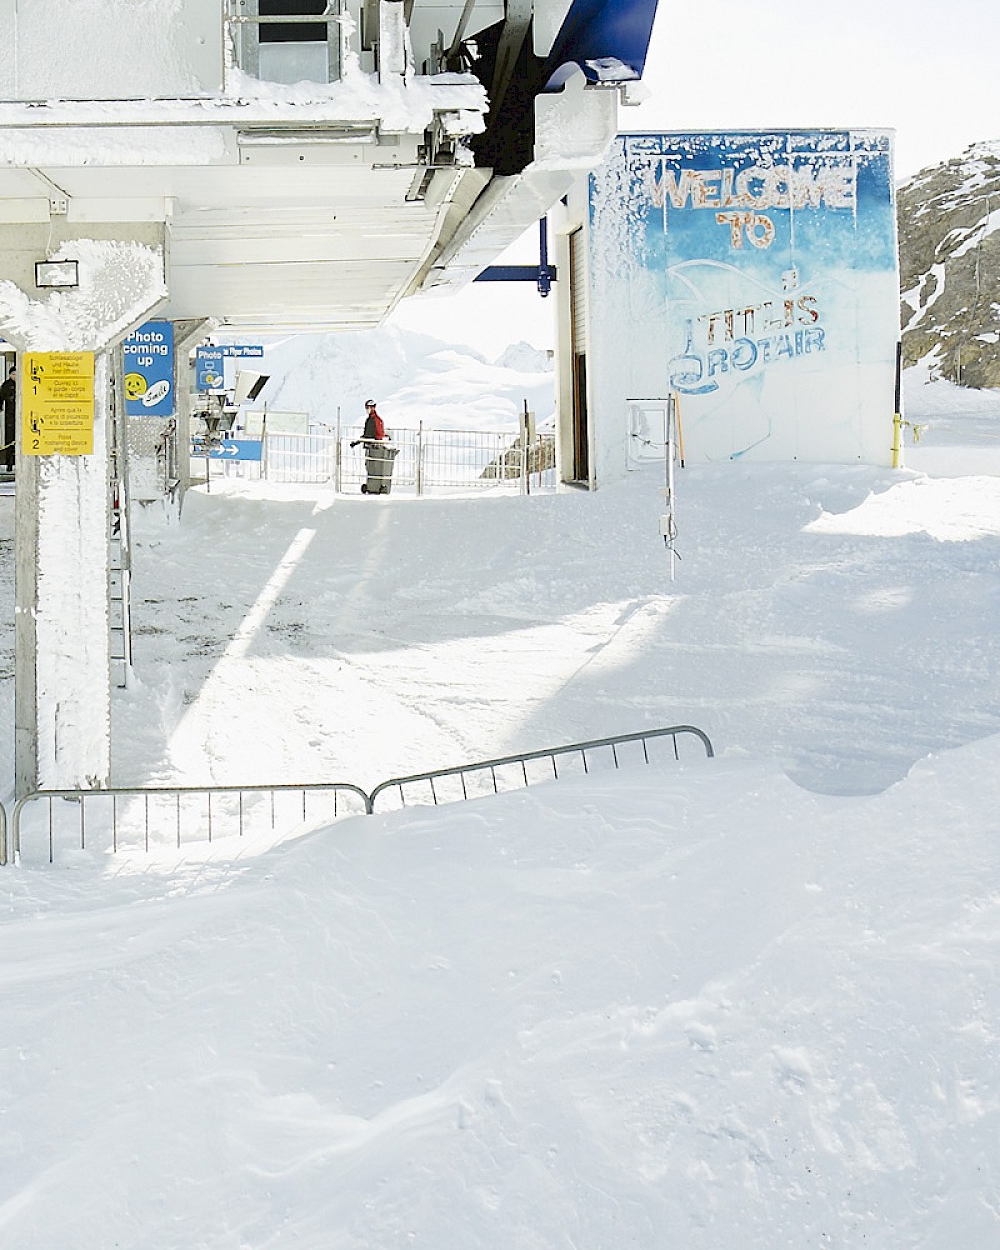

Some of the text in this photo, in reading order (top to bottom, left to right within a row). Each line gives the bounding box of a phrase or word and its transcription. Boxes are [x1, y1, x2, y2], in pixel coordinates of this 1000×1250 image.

[643, 165, 857, 210] WELCOME
[715, 210, 776, 250] TO
[697, 295, 820, 346] TITLIS
[127, 331, 164, 342] Photo
[124, 343, 169, 356] coming
[198, 350, 222, 360] Photo
[707, 327, 827, 377] ROTAIR
[137, 356, 154, 367] up
[32, 385, 37, 395] 1
[32, 439, 39, 449] 2
